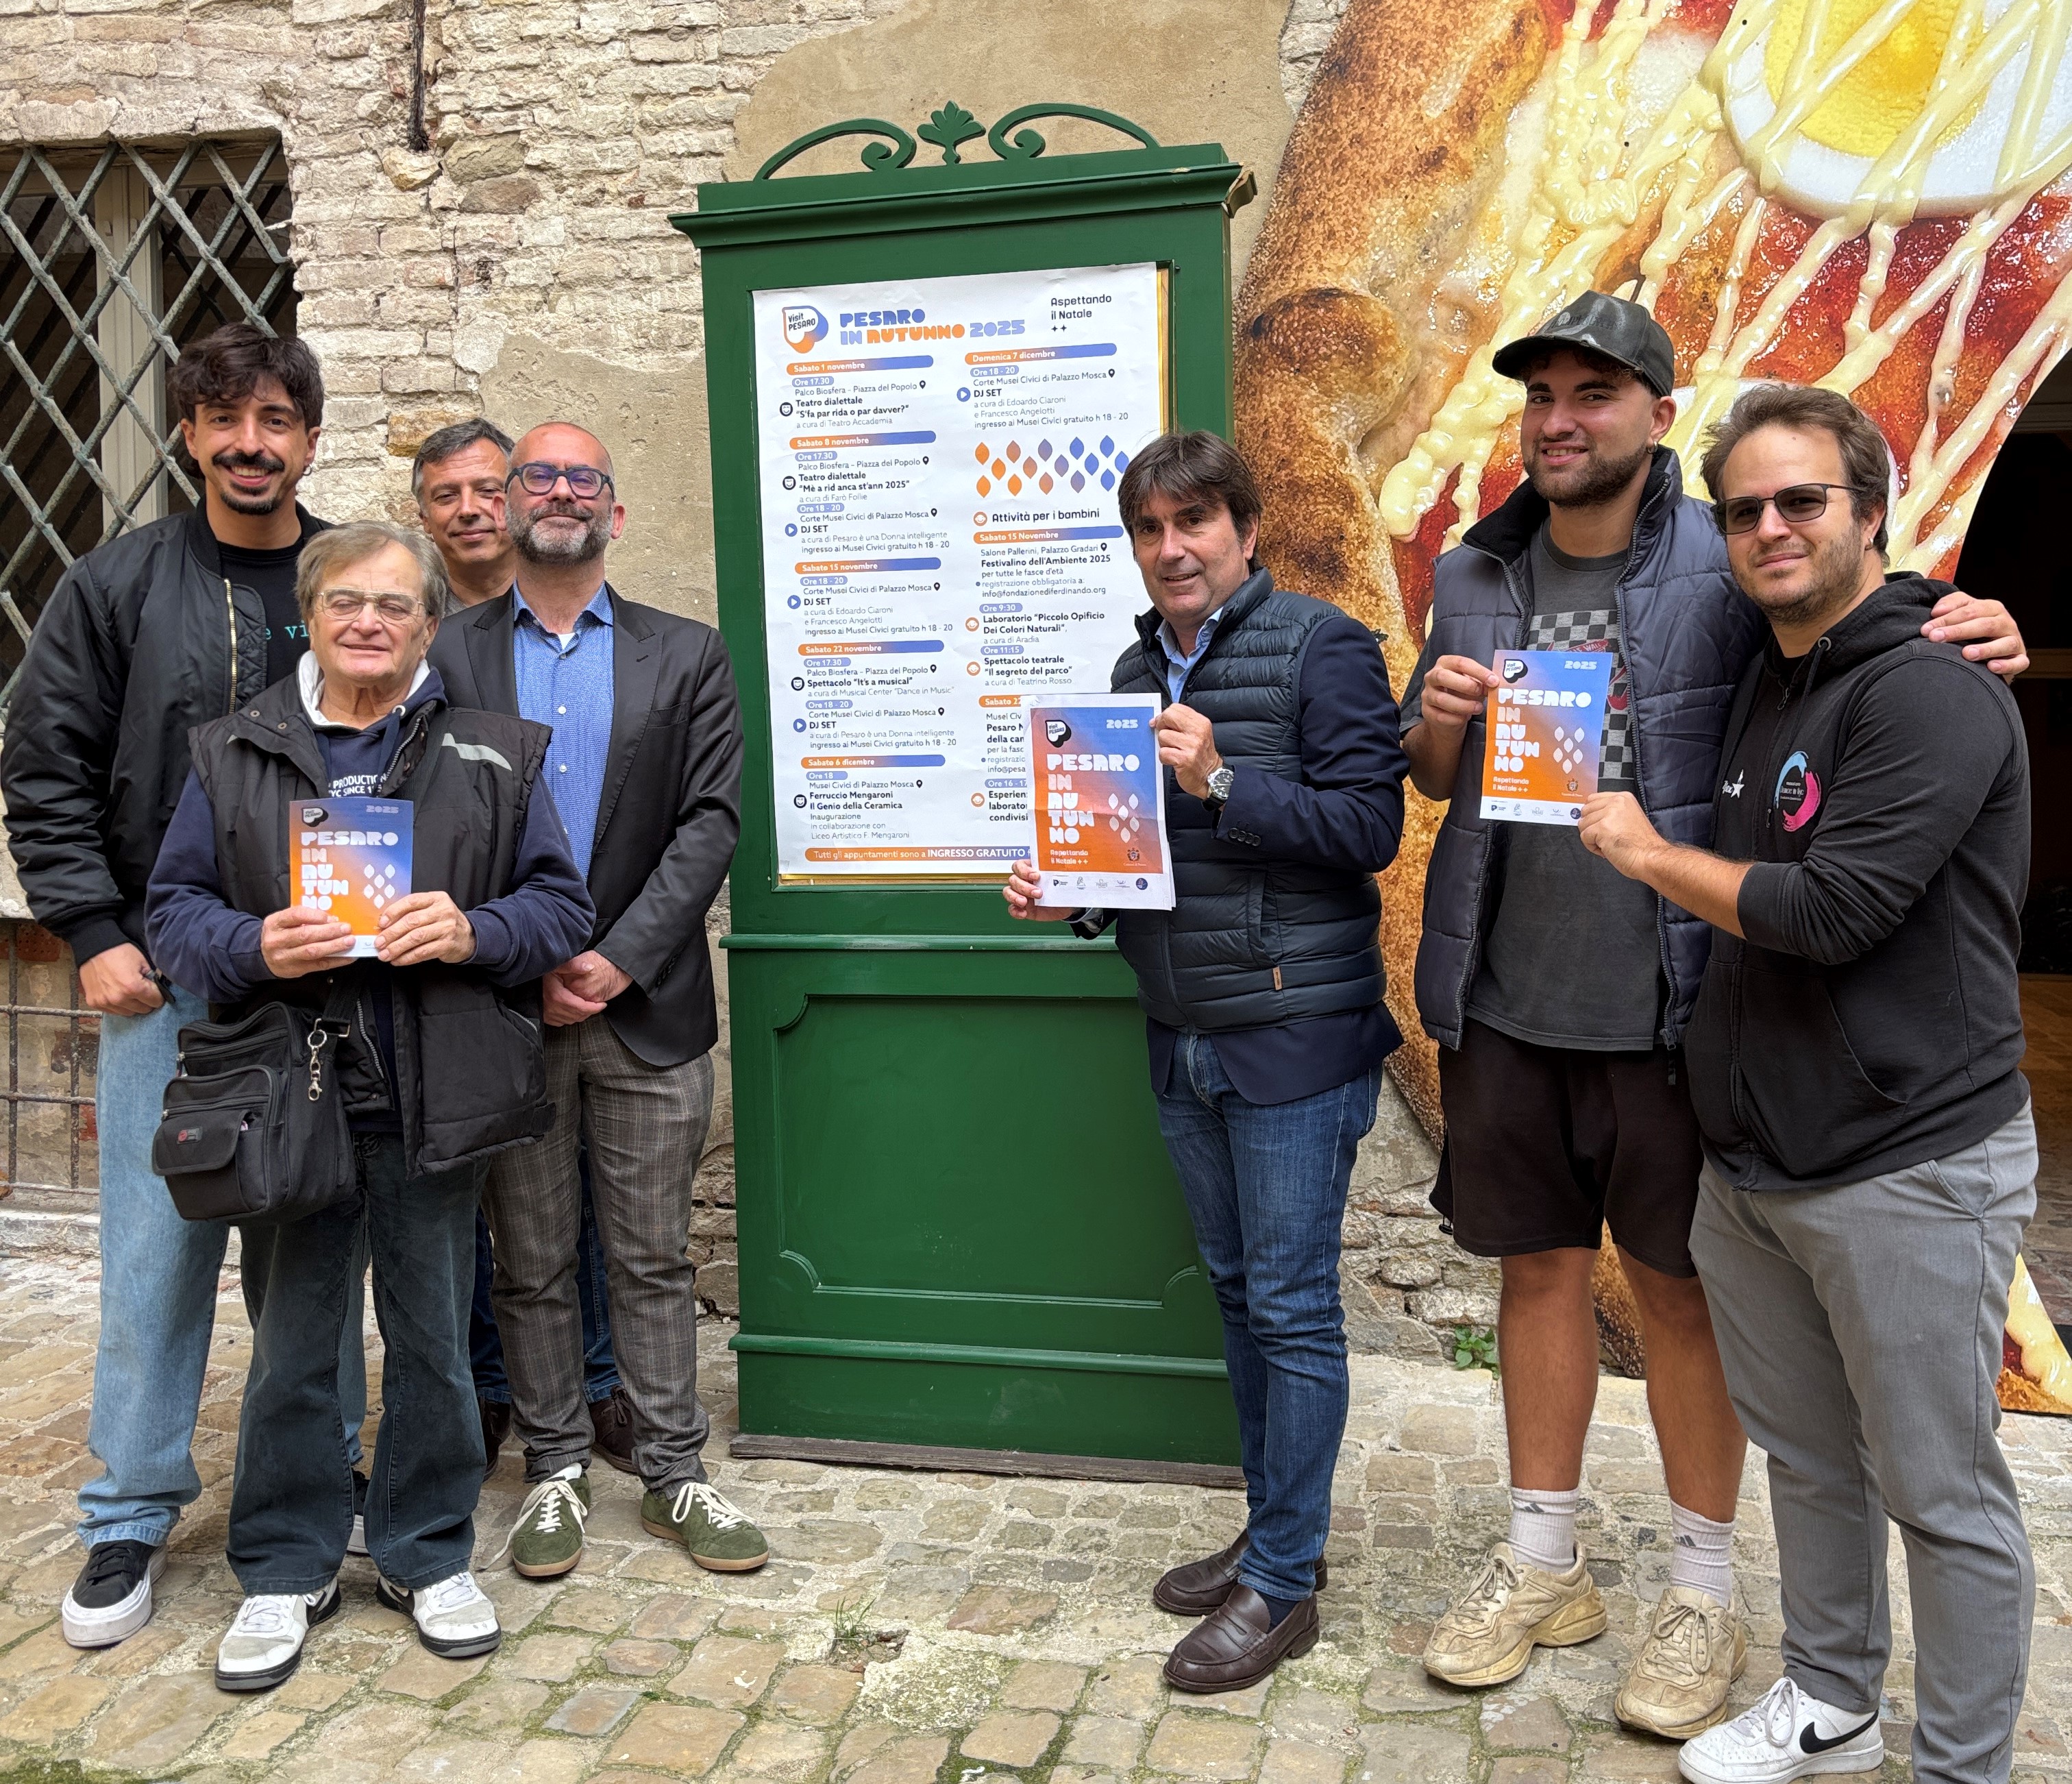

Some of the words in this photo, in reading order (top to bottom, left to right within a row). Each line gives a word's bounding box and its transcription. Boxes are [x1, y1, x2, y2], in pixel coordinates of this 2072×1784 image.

[1050, 294, 1112, 308] Aspettando
[788, 312, 804, 323] Visit
[839, 310, 926, 328] PESARO
[1051, 310, 1056, 320] il
[1059, 308, 1092, 319] Natale
[788, 317, 817, 331] PESARO
[840, 330, 863, 345] IN
[867, 323, 966, 345] AUTUNNO
[970, 319, 1026, 339] 2025
[972, 353, 1011, 362] Domenica
[1019, 350, 1055, 359] dicembre
[793, 364, 819, 372] Sabato
[827, 362, 865, 371] novembre
[810, 378, 830, 386] 17.30
[974, 389, 984, 398] DJ
[985, 388, 1002, 397] SET
[795, 399, 822, 407] Teatro
[824, 395, 863, 406] dialettale
[817, 411, 830, 419] par
[832, 408, 848, 416] rida
[857, 408, 871, 417] par
[797, 439, 823, 448] Sabato
[824, 438, 830, 446] 8
[831, 437, 870, 446] novembre
[827, 470, 866, 480] dialettale
[824, 482, 835, 491] rid
[846, 513, 865, 521] Civici
[876, 511, 903, 520] Palazzo
[904, 510, 930, 518] Mosca
[992, 511, 1030, 522] Attività
[1033, 513, 1050, 523] per
[1052, 511, 1055, 520] i
[1058, 508, 1099, 520] bambini
[800, 525, 811, 533] DJ
[813, 524, 828, 533] SET
[979, 533, 1007, 541] Sabato
[1007, 532, 1017, 540] 15
[1018, 530, 1058, 539] Novembre
[981, 548, 1006, 557] Salone
[1041, 546, 1070, 554] Palazzo
[1070, 544, 1098, 553] Gradari
[981, 558, 1026, 567] Festivalino
[1089, 554, 1110, 563] 2025
[802, 563, 828, 572] Sabato
[840, 562, 878, 570] novembre
[815, 597, 831, 605] SET
[998, 604, 1015, 612] 9:30
[983, 613, 1032, 623] Laboratorio
[1070, 611, 1105, 622] Opificio
[983, 626, 998, 634] Dei
[999, 625, 1025, 633] Colori
[805, 645, 832, 653] Sabato
[833, 645, 843, 653] 22
[844, 644, 882, 653] novembre
[984, 655, 1029, 667] Spettacolo
[1031, 655, 1064, 663] teatrale
[1564, 660, 1598, 671] 2025
[995, 668, 1028, 677] segreto
[1030, 666, 1043, 674] del
[807, 678, 852, 689] Spettacolo
[1498, 688, 1592, 708] PESARO
[1496, 707, 1521, 723] IN
[1106, 719, 1139, 729] 2025
[808, 758, 834, 769] Sabato
[1046, 754, 1140, 772] PESARO
[824, 772, 834, 780] 18
[1047, 774, 1073, 791] IN
[343, 785, 366, 796] SINCE
[849, 790, 893, 801] Mengaroni
[988, 790, 1028, 800] Esperien
[817, 802, 841, 810] Genio
[842, 801, 862, 809] della
[301, 831, 399, 846] PESARO
[871, 831, 909, 840] Mengaroni
[301, 848, 328, 864] IN
[813, 851, 832, 859] Tutti
[832, 850, 842, 860] gli
[843, 851, 898, 859] appuntamenti
[927, 848, 974, 857] INGRESSO
[976, 848, 1025, 857] GRATUITO
